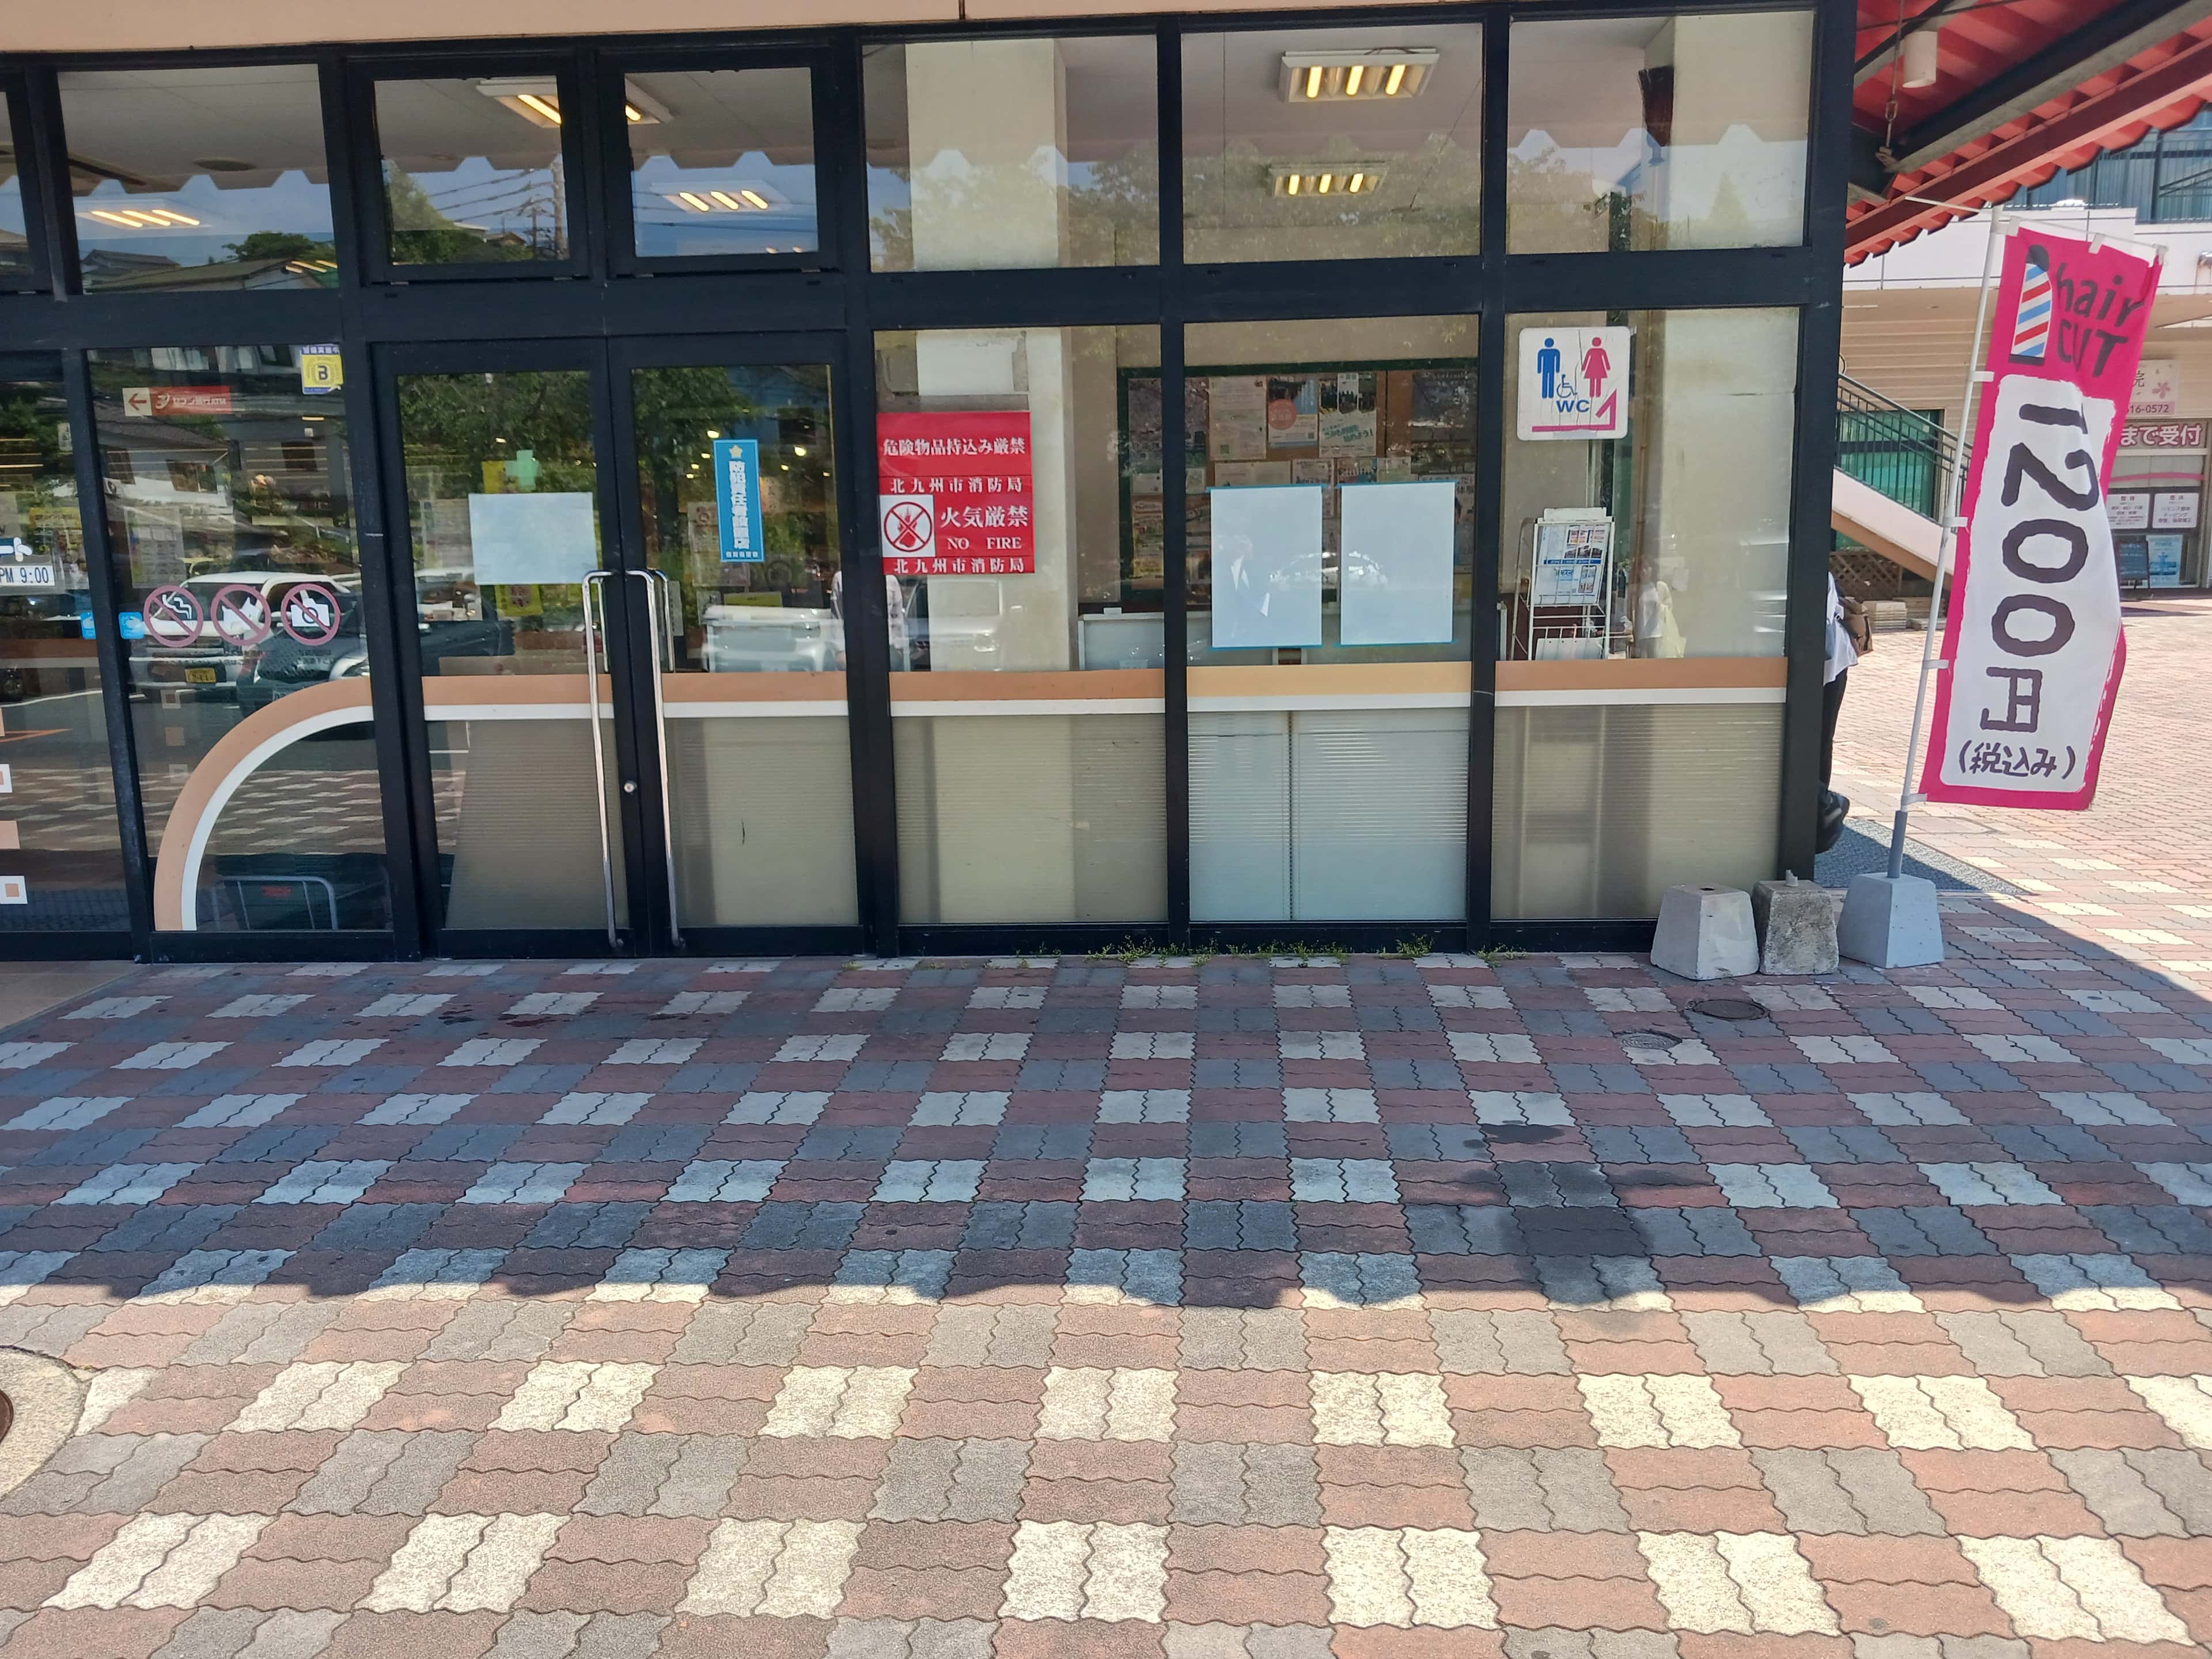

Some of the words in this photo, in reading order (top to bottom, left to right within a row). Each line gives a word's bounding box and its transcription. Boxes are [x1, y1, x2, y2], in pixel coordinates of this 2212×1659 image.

[2056, 263, 2145, 327] hair
[2057, 319, 2129, 377] CUT
[1556, 399, 1590, 412] WC
[2120, 423, 2203, 446] まで受付
[883, 437, 1026, 457] 危険物品持込み厳禁
[890, 476, 1023, 494] 北九州市消防局
[940, 505, 1029, 529] 火気厳禁
[948, 537, 970, 550] NO
[986, 536, 1022, 550] FIRE
[20, 567, 49, 584] 9:00
[894, 557, 1025, 574] 北九州市消防局
[1980, 403, 2100, 733] 1200円
